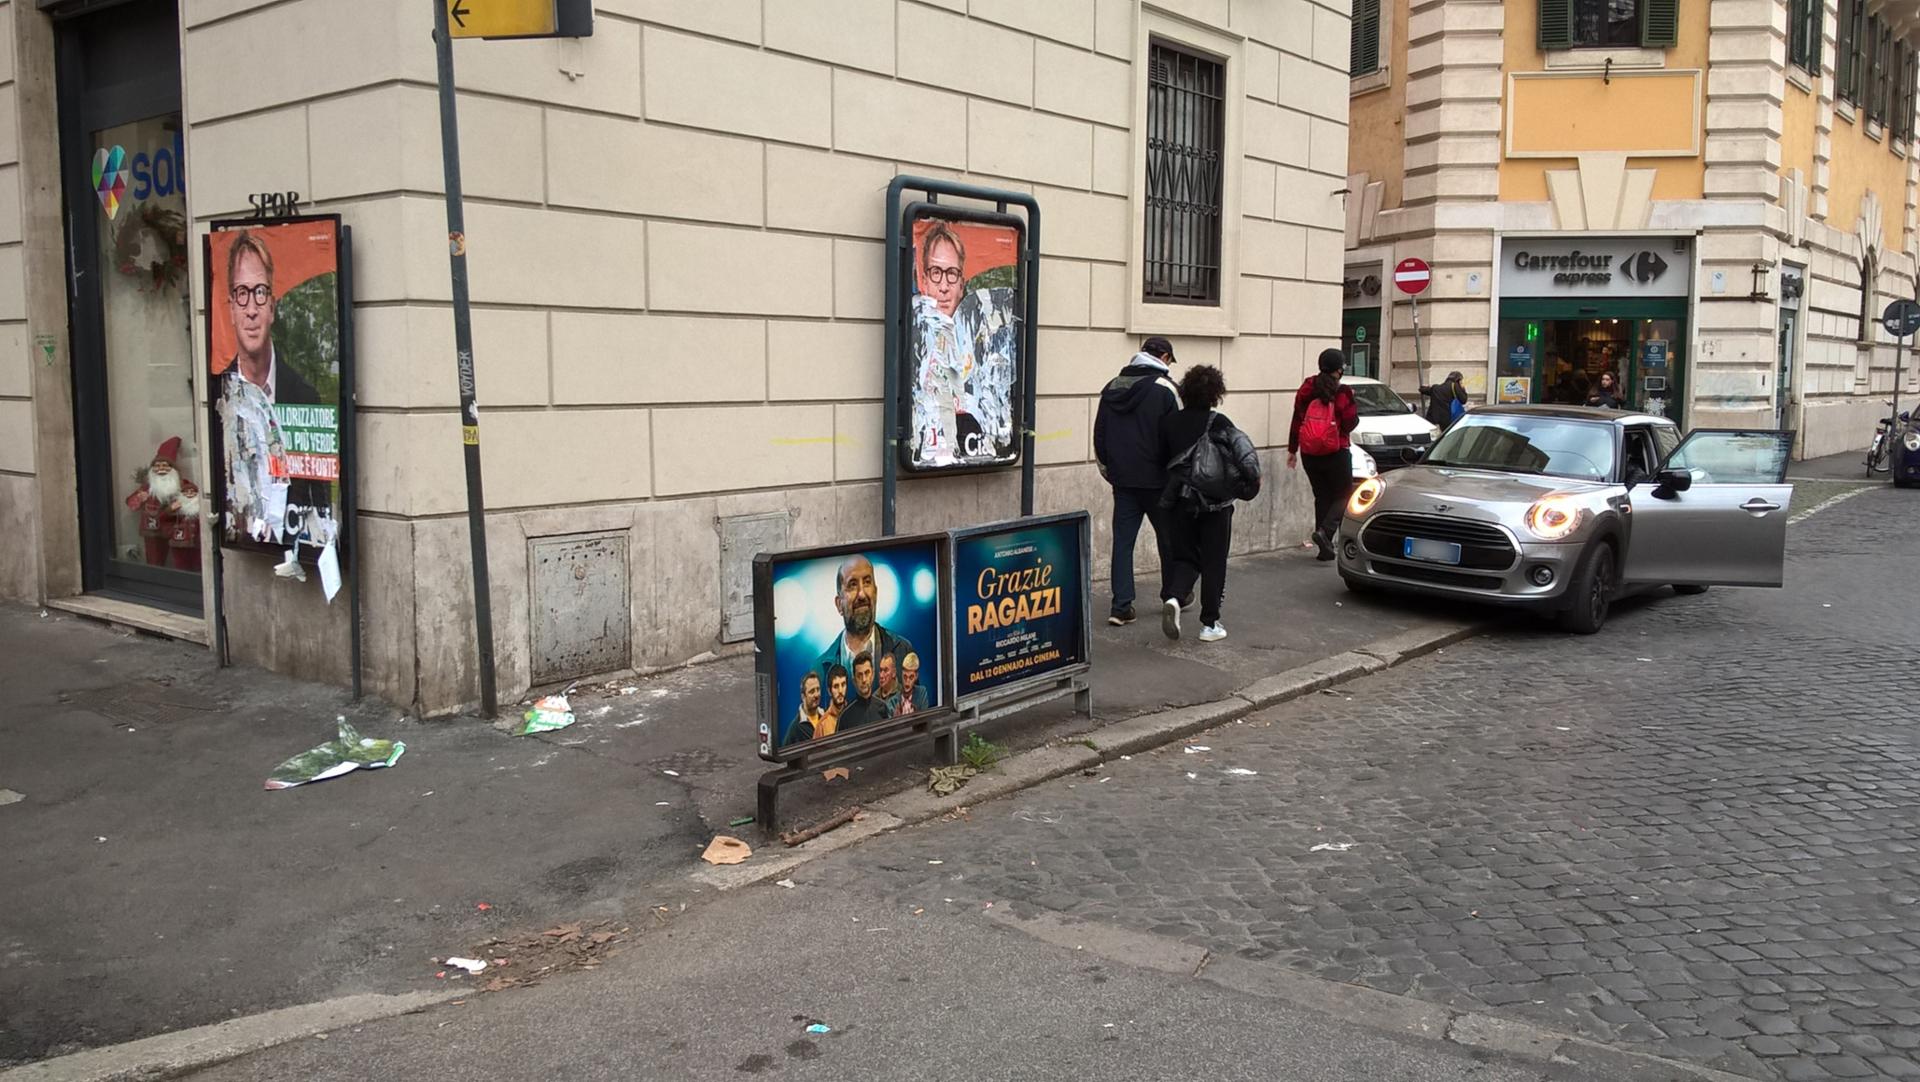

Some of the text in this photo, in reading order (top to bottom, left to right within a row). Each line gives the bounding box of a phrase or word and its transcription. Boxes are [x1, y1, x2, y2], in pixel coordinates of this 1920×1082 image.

[248, 191, 300, 217] SPQR
[1514, 251, 1613, 269] Carrefour
[1553, 272, 1612, 288] express
[977, 557, 1052, 600] Grazie
[968, 587, 1061, 634] RAGAZZI
[970, 671, 984, 683] DAL
[985, 668, 992, 678] 12
[993, 660, 1025, 676] GENNAIO
[1025, 656, 1033, 667] AL
[1034, 649, 1060, 664] CINEMA
